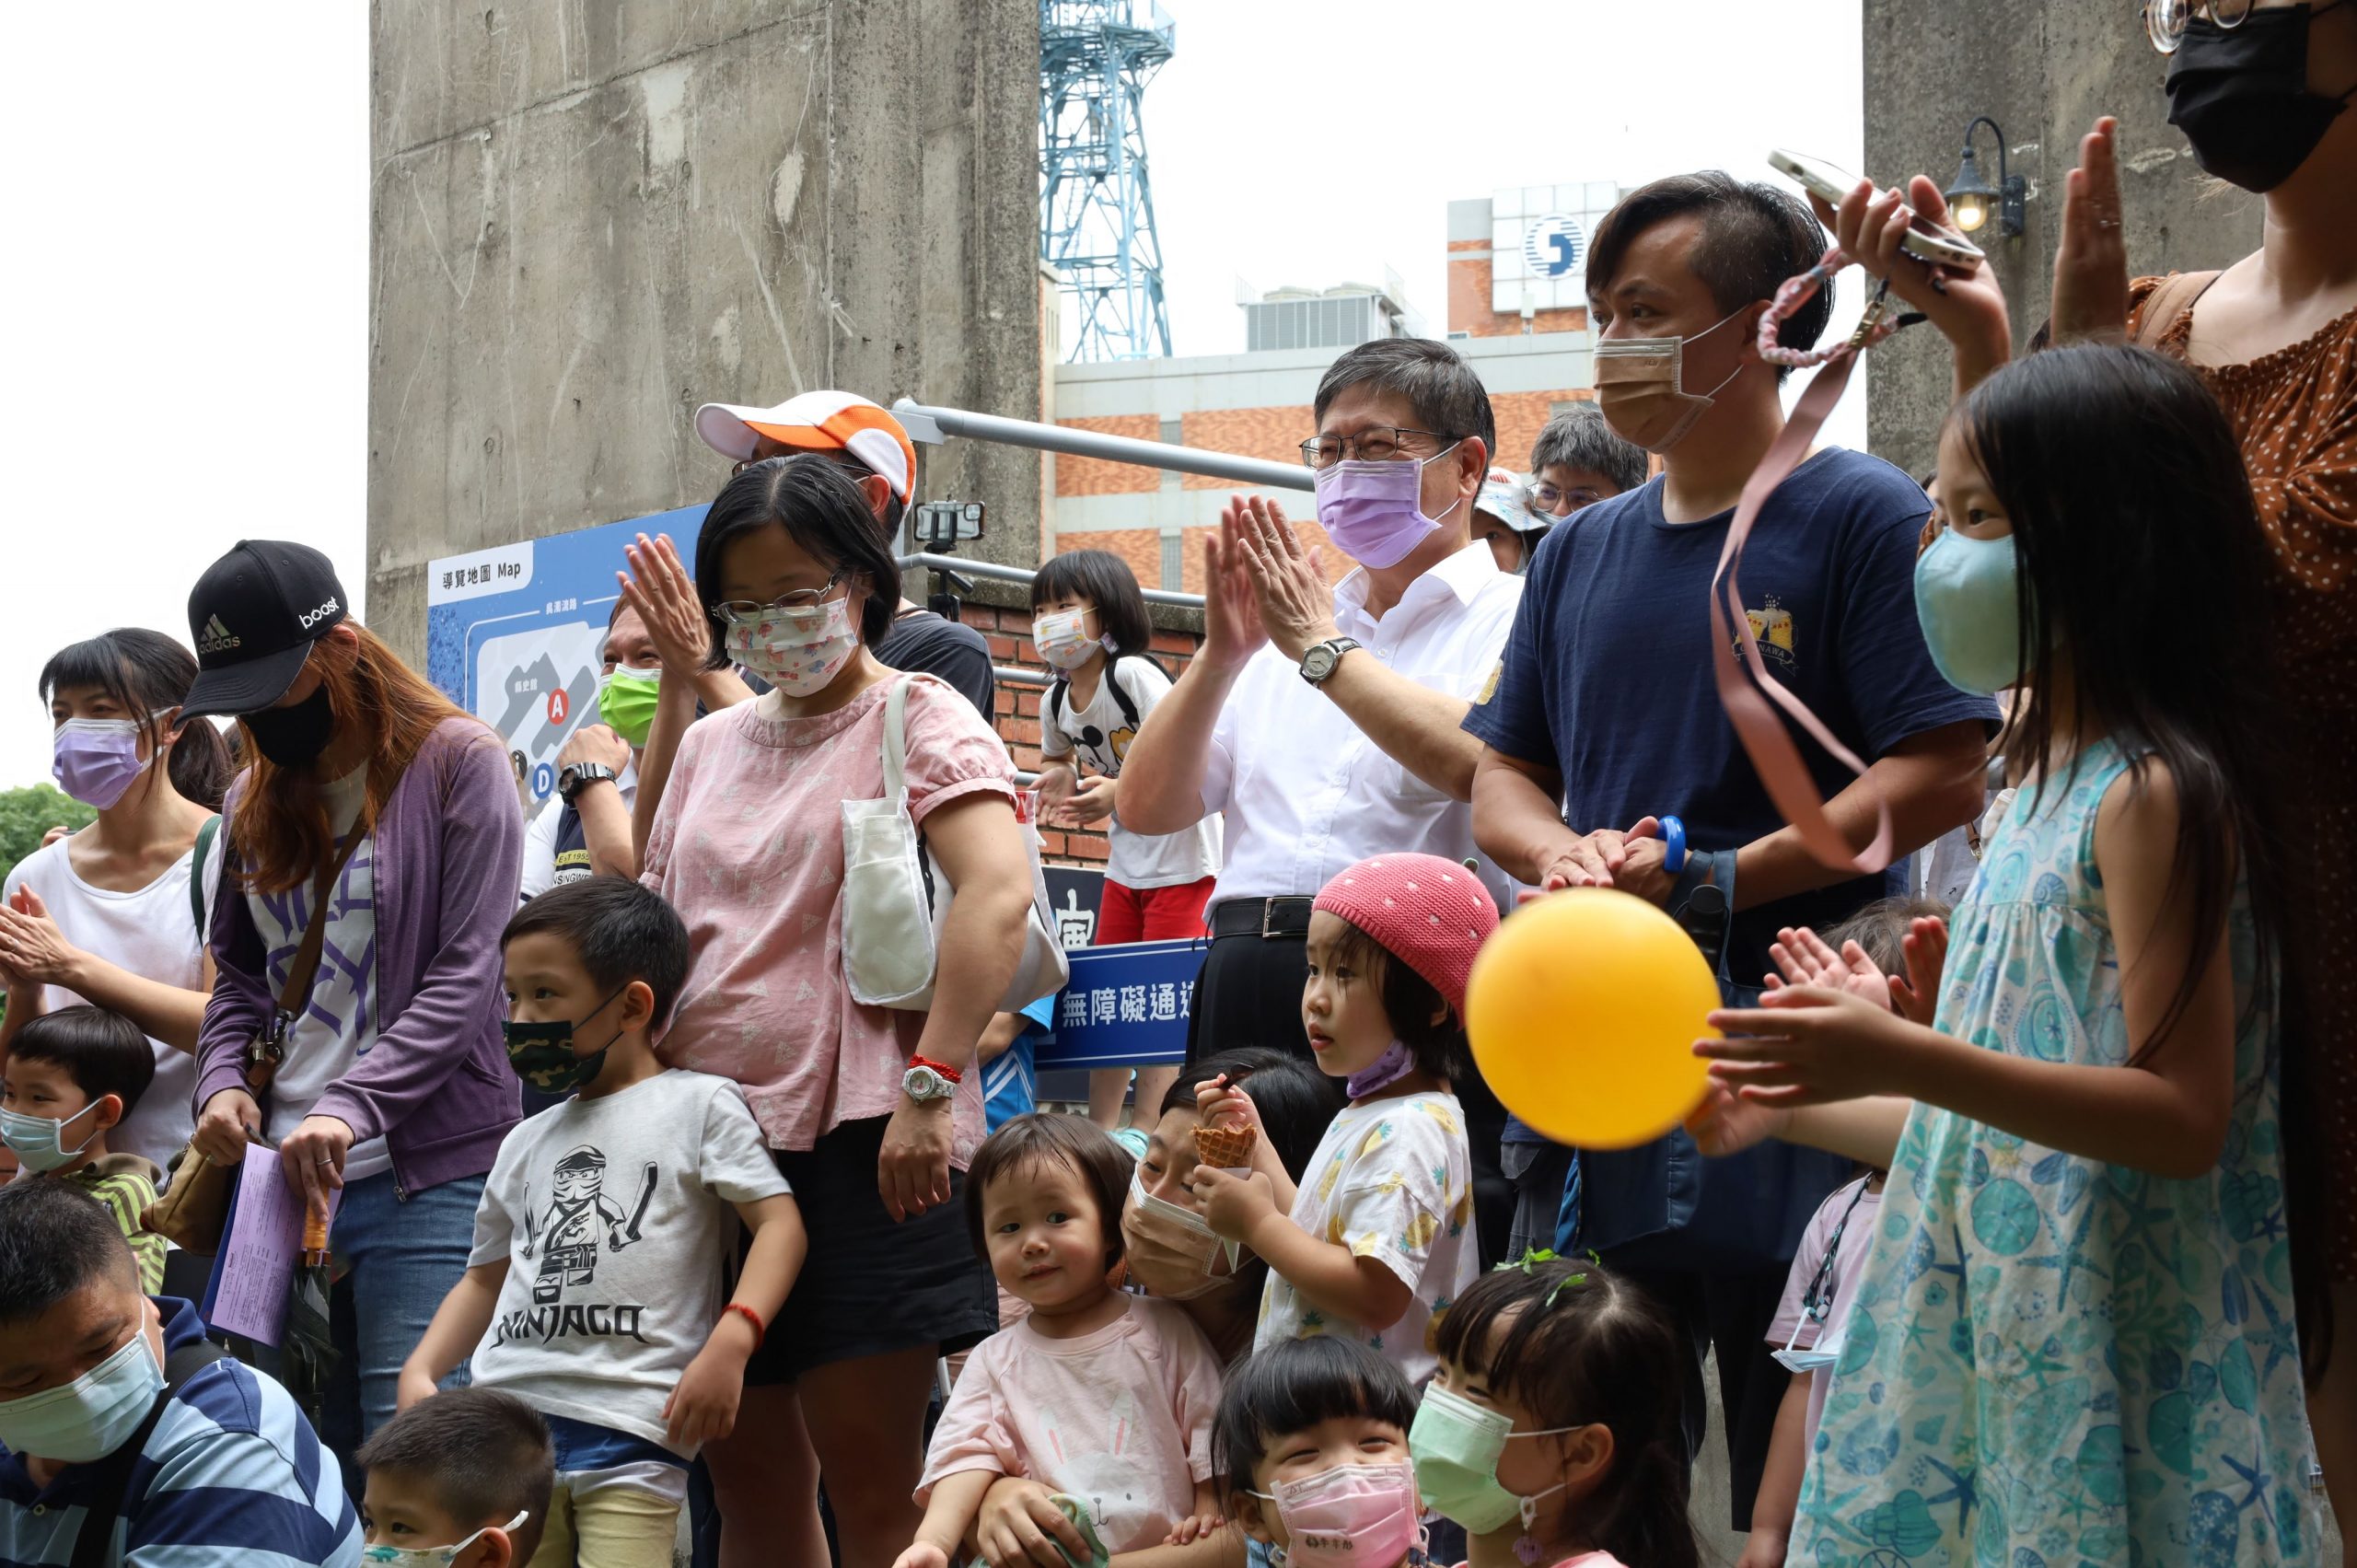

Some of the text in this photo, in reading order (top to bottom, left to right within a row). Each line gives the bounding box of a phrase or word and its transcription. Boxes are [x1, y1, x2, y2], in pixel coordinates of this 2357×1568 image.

[443, 561, 521, 589] 導覽地圖 Map
[299, 596, 340, 630] boost
[199, 635, 241, 655] adidas
[1740, 645, 1784, 657] ONAWA
[552, 695, 564, 718] A
[538, 769, 550, 793] D
[489, 1305, 650, 1350] NINJAGO
